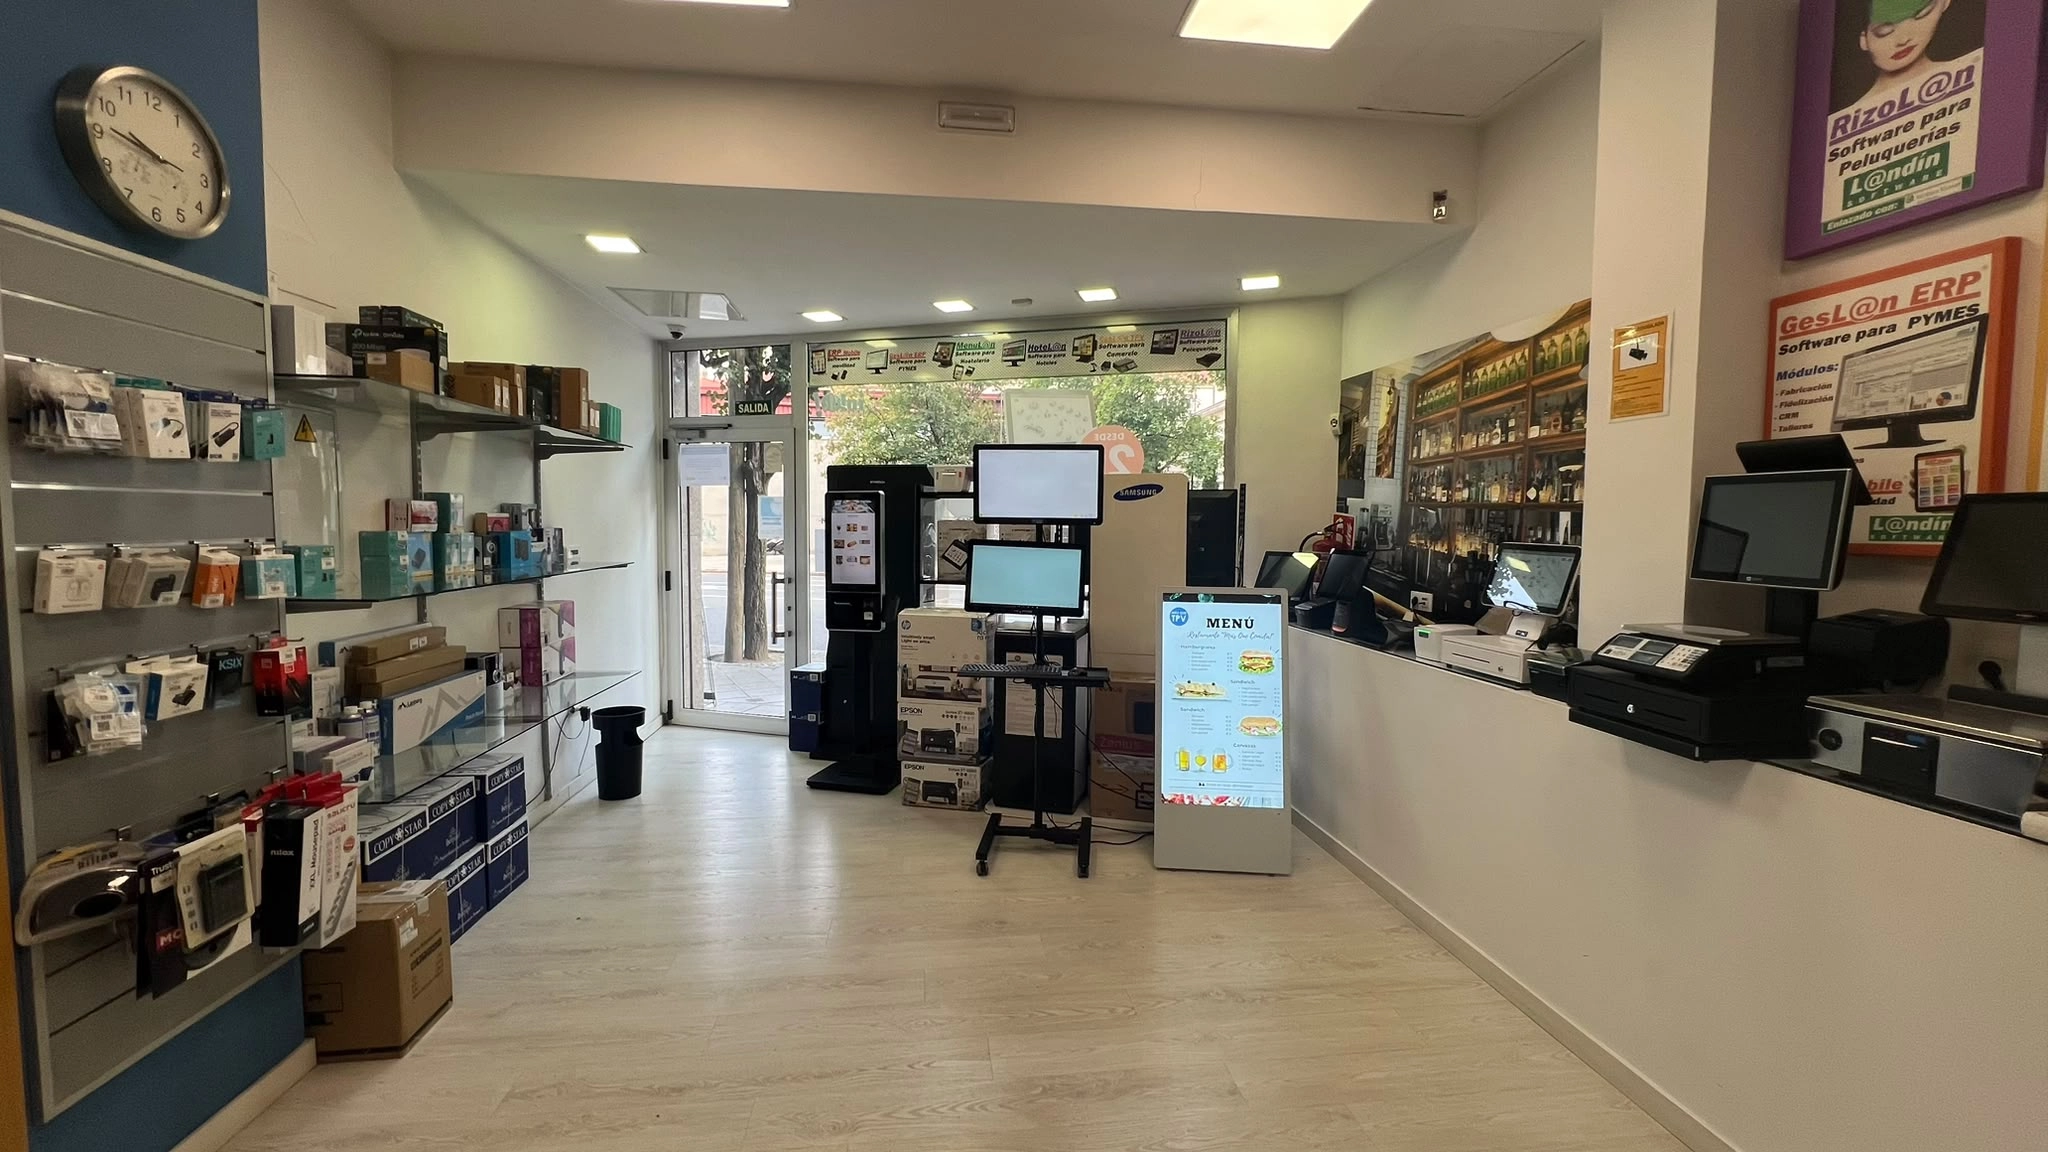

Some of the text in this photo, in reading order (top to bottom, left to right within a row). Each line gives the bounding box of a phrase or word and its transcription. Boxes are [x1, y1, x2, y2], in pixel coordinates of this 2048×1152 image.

[117, 87, 133, 105] 11
[144, 91, 163, 112] 12
[1829, 64, 1975, 141] RizoL@n
[98, 97, 116, 117] 10
[173, 114, 181, 129] 1
[93, 123, 104, 139] 9
[1828, 97, 1971, 163] Software para
[191, 142, 201, 158] 2
[1839, 121, 1960, 176] Peluquerías
[102, 158, 112, 174] 8
[1849, 151, 1941, 196] L@ndín
[200, 174, 208, 188] 3
[124, 188, 134, 200] 7
[152, 207, 162, 222] 6
[176, 208, 186, 223] 5
[195, 201, 203, 214] 4
[1826, 209, 1873, 231] Enlazado
[1779, 270, 1983, 341] GesL@n ERP
[1778, 303, 1980, 356] Software para PYMES
[1776, 363, 1839, 381] Módulos:
[738, 403, 769, 414] SALIDA
[1778, 411, 1799, 420] CRM
[1171, 614, 1187, 622] TPV
[1206, 616, 1255, 629] MENÚ
[218, 658, 243, 671] KSIX
[490, 763, 522, 787] COPY STAR
[432, 788, 471, 819] COPY STAR
[373, 818, 423, 855] COPY STAR
[513, 826, 526, 842] STAR
[151, 862, 174, 876] Trust
[467, 855, 482, 873] STAR
